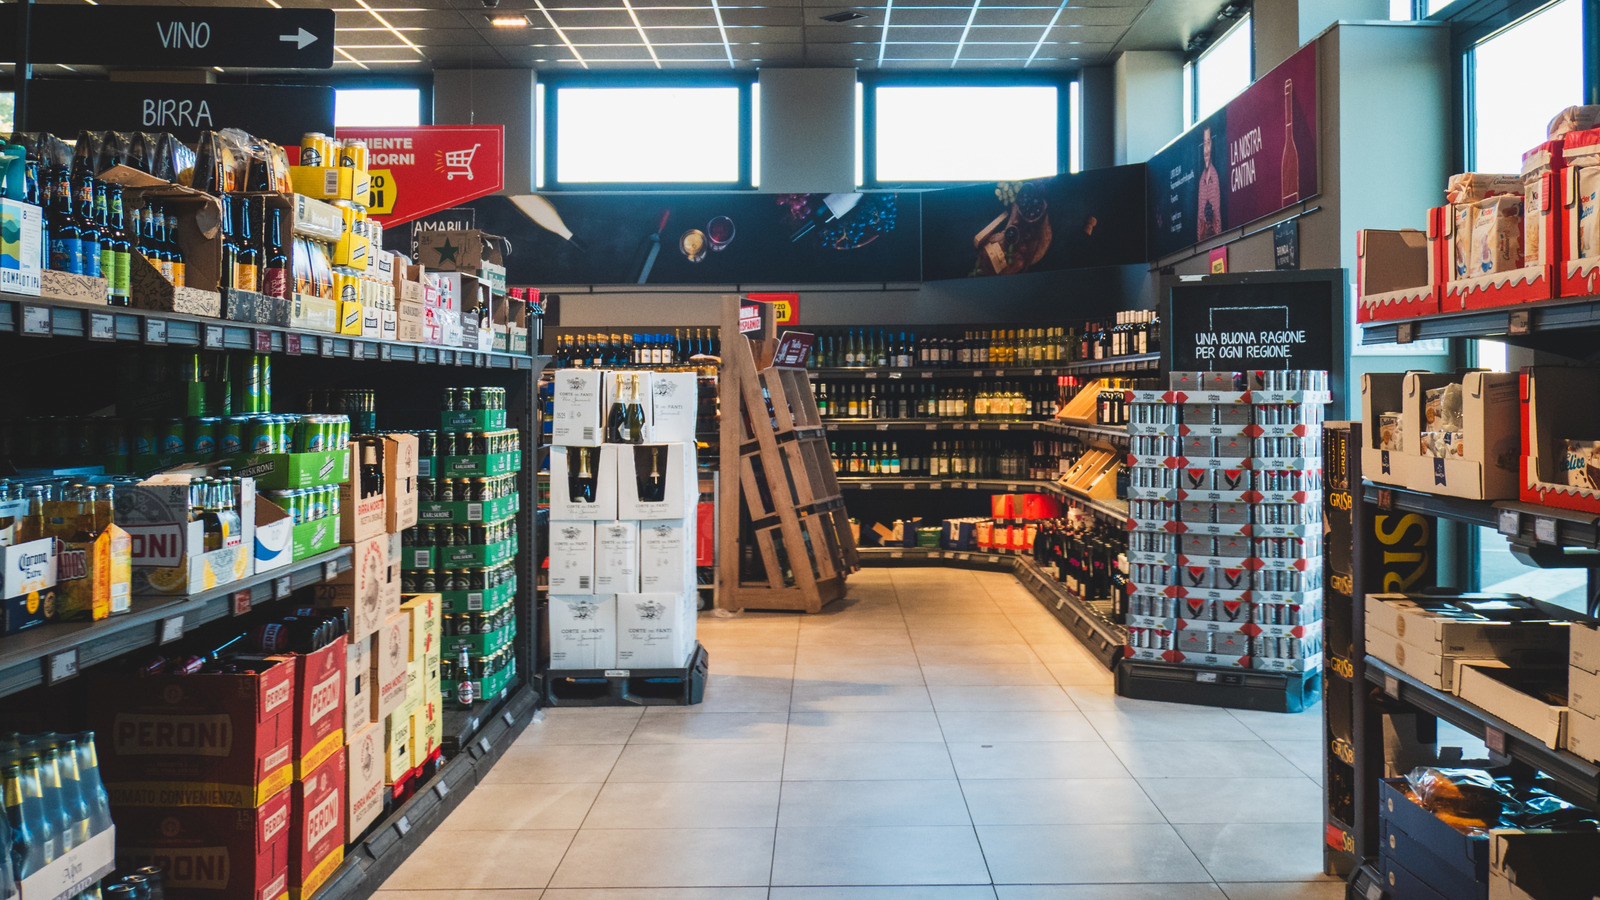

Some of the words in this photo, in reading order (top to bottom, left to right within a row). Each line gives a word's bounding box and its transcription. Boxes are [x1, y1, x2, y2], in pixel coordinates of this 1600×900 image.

[157, 21, 211, 49] VINO
[143, 98, 213, 127] BIRRA
[1230, 142, 1239, 166] LA
[1239, 126, 1263, 162] NOSTRA
[1230, 158, 1257, 192] CANTINA
[2, 271, 30, 288] COMPLOT
[30, 276, 39, 289] IPA
[1195, 332, 1218, 345] UNA
[1221, 331, 1256, 344] BUONA
[1260, 330, 1306, 344] RAGIONE
[1195, 346, 1216, 359] PER
[1219, 346, 1243, 358] OGNI
[1246, 345, 1292, 358] REGIONE.
[18, 552, 48, 572] Corona
[311, 677, 339, 718] PERONI
[119, 721, 228, 748] PERONI
[160, 790, 243, 805] CONVENIENZA
[264, 807, 287, 838] PERONI
[308, 799, 338, 844] PERONI
